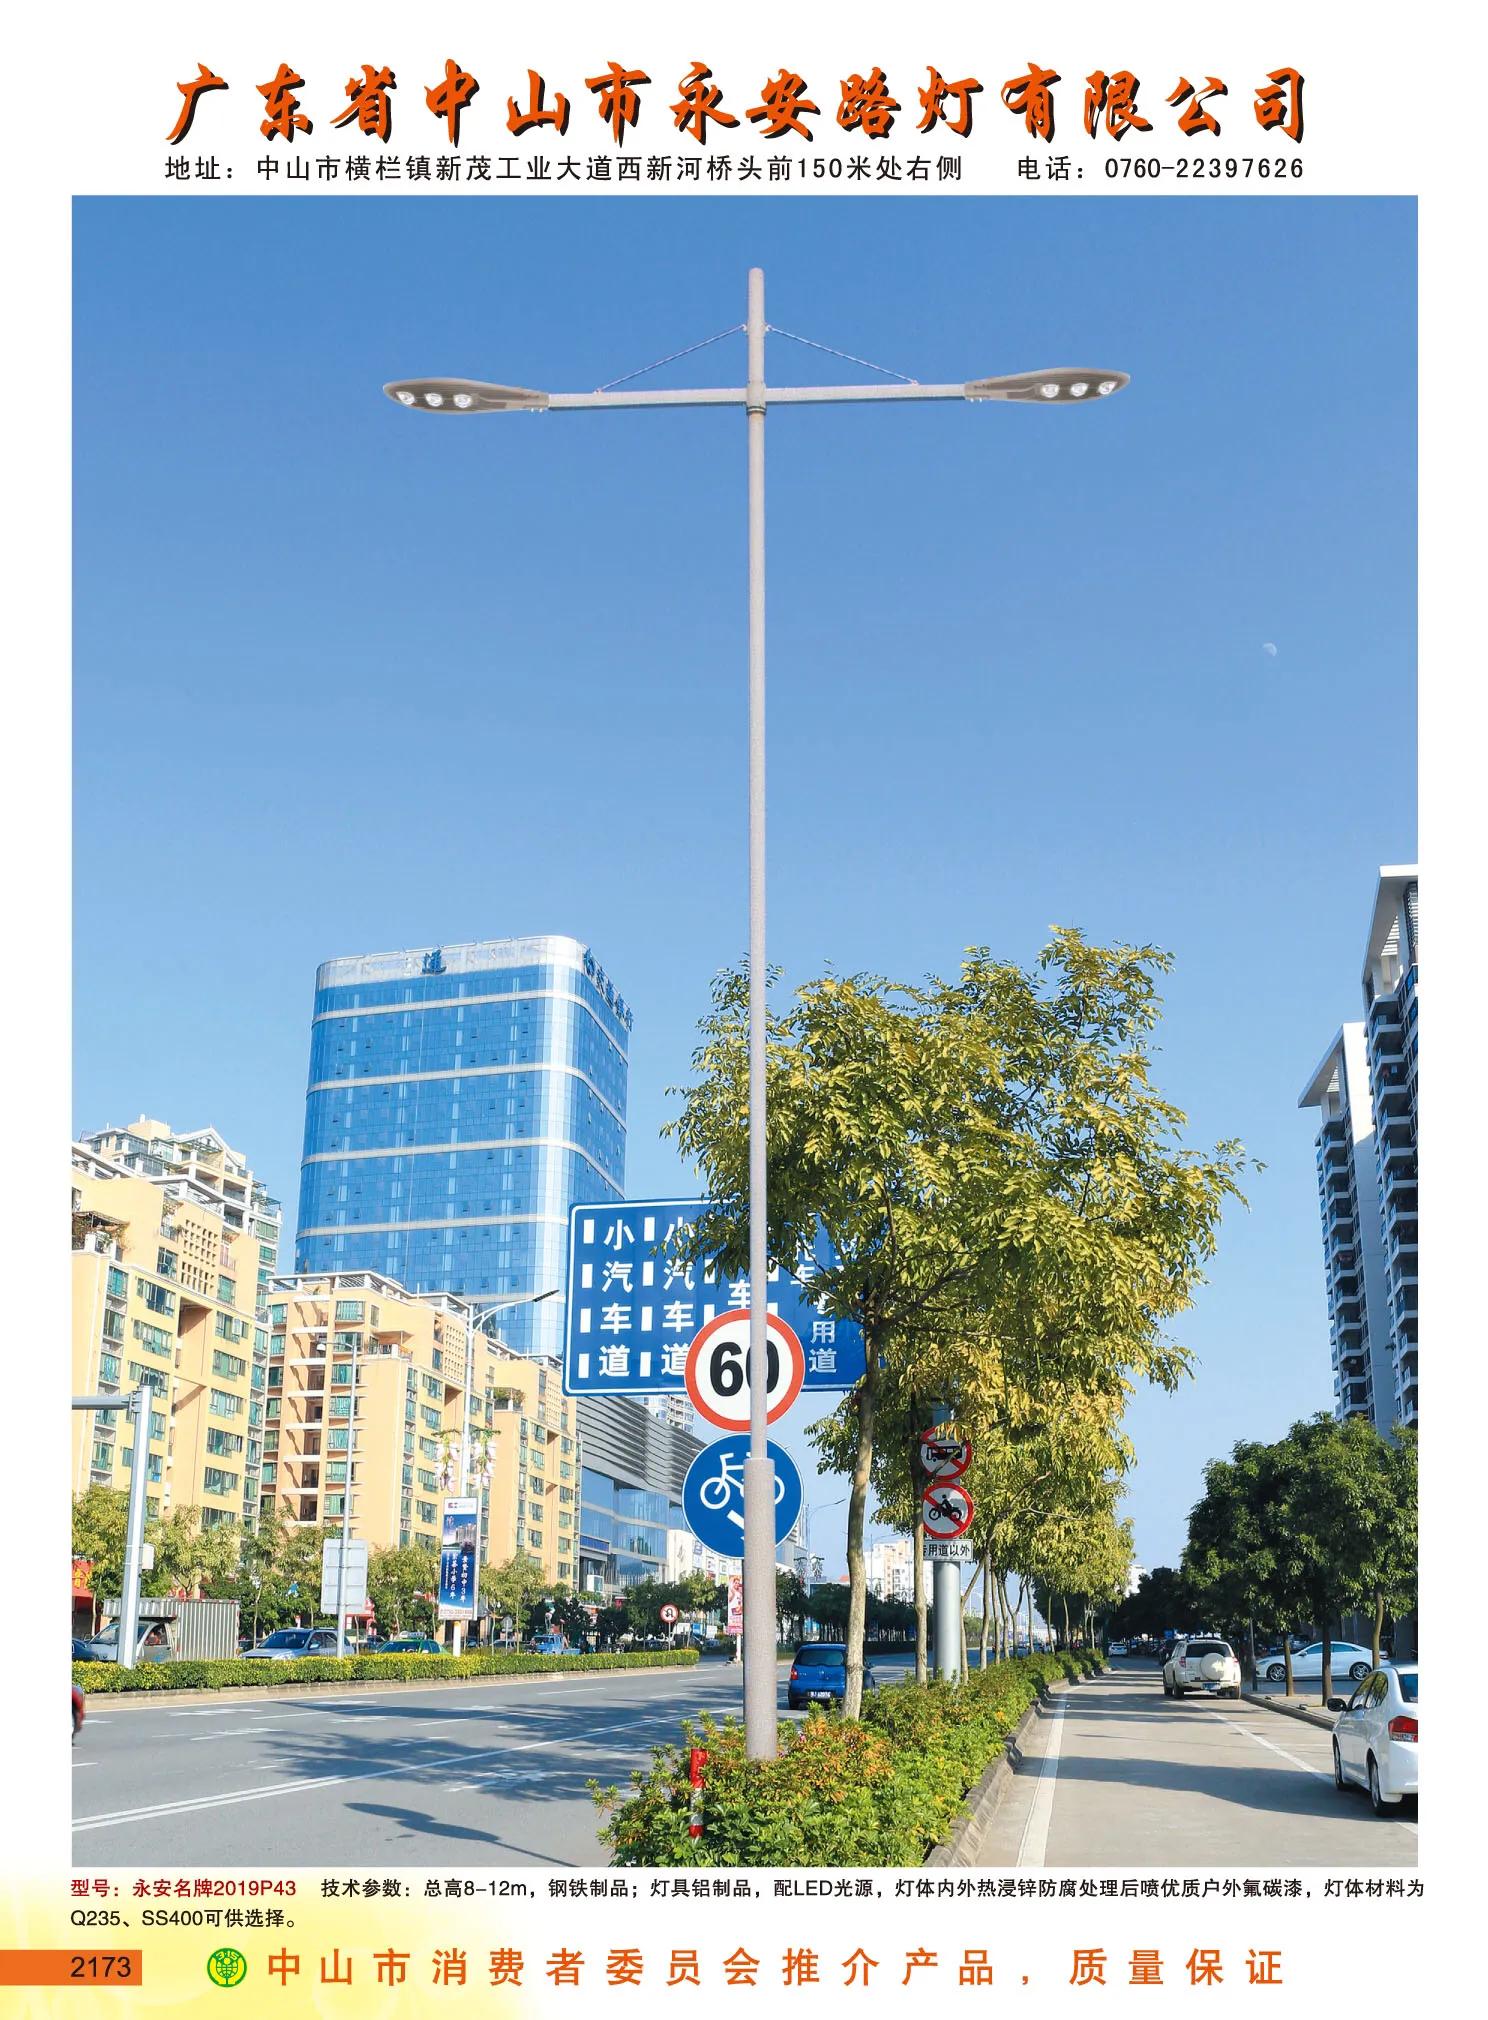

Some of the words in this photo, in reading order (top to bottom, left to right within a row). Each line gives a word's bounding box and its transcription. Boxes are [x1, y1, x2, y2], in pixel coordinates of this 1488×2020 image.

[598, 1218, 636, 1378] 小汽车道
[709, 1341, 781, 1397] 60
